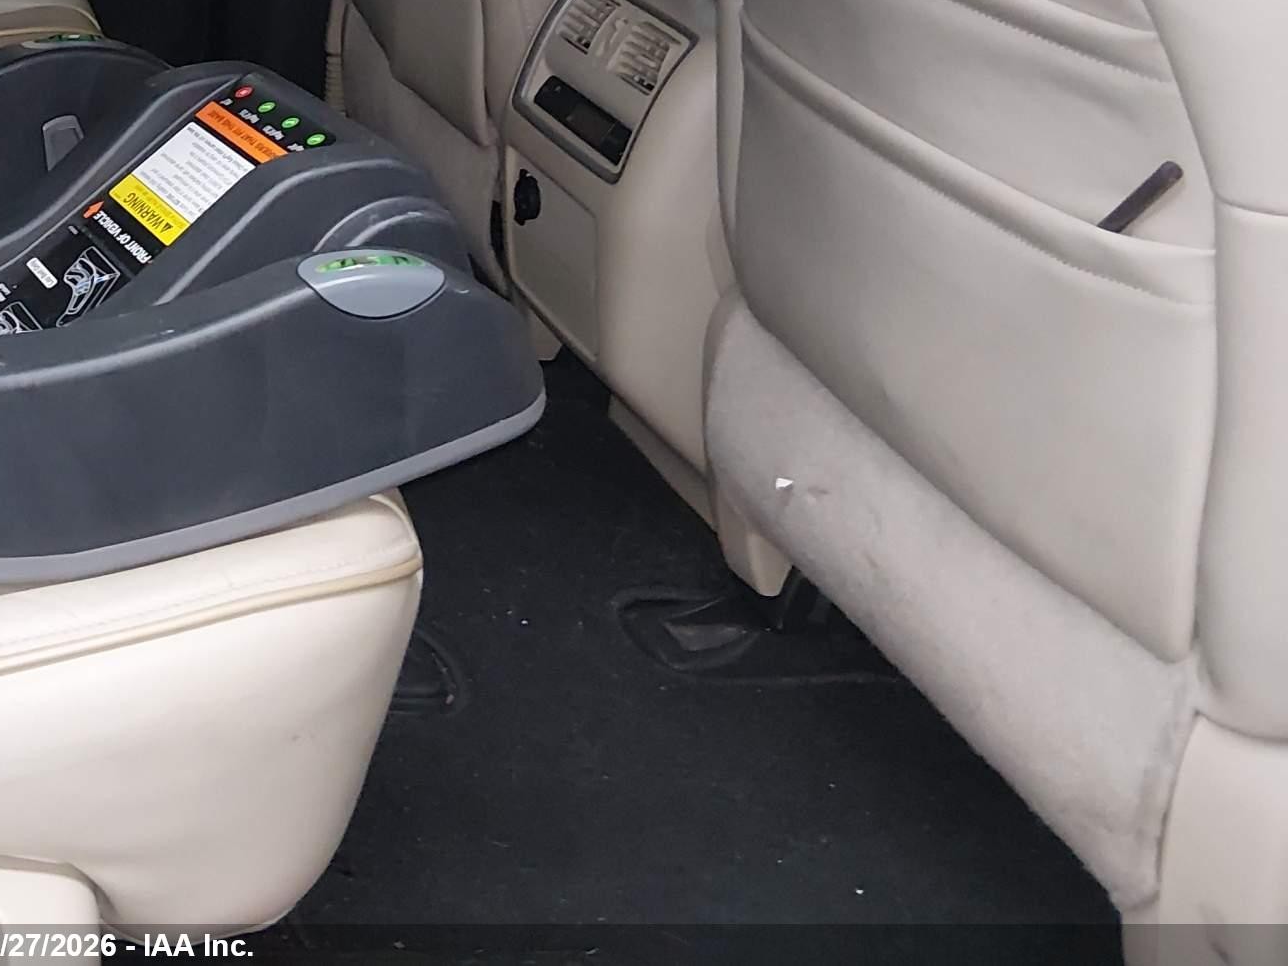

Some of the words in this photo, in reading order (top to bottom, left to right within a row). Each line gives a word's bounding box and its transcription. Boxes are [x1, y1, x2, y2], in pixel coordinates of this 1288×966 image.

[92, 210, 123, 237] VEHICLE
[123, 192, 165, 230] WARNING
[115, 233, 131, 244] OF
[124, 240, 152, 264] FRONT
